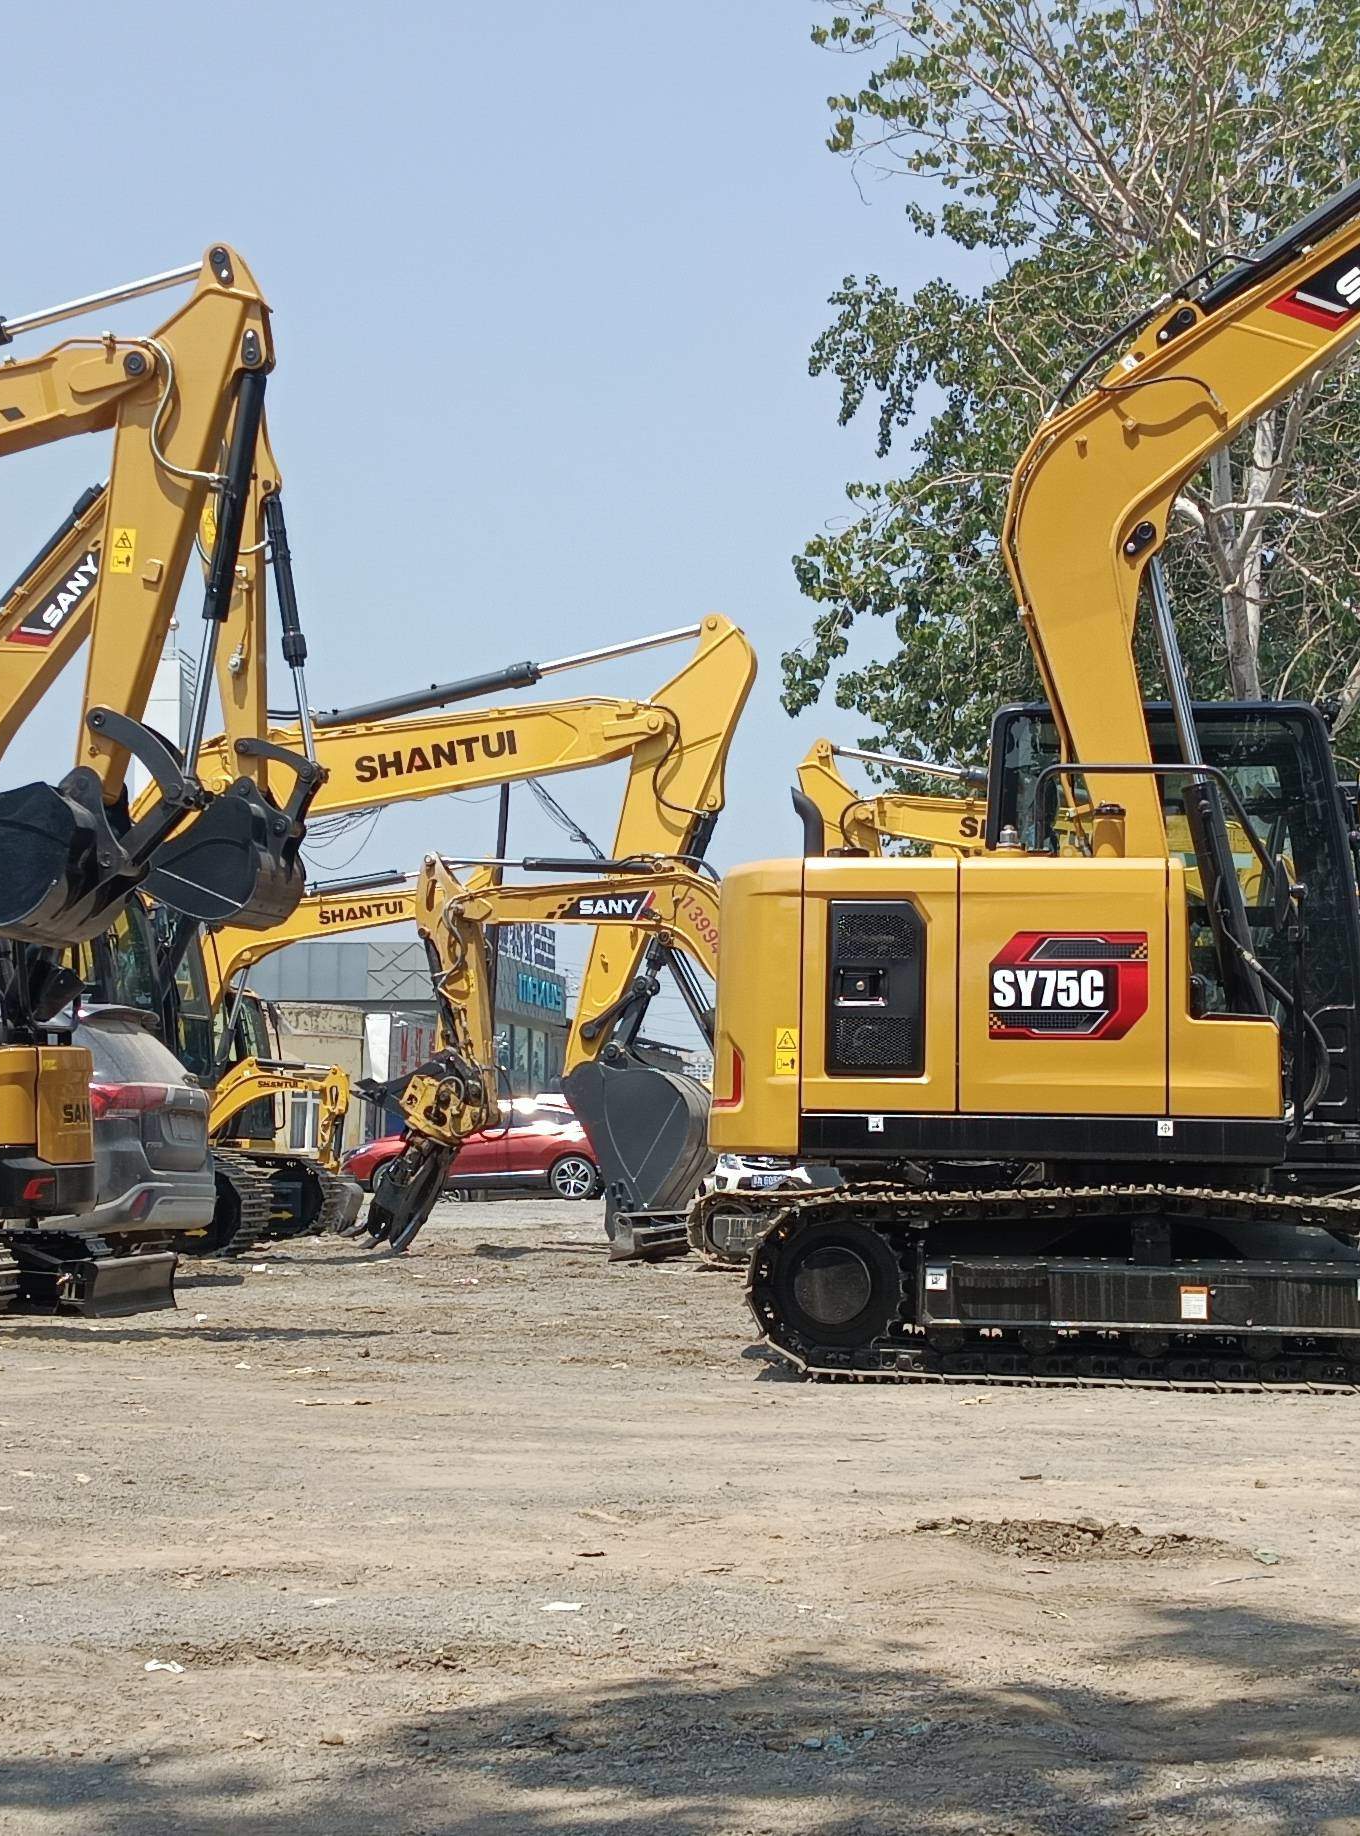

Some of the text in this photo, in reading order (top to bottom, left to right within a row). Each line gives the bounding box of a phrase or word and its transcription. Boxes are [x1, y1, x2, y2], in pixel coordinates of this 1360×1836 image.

[42, 553, 98, 629] SANY
[355, 729, 518, 783] SHANTUI
[319, 901, 404, 925] SHANTUI
[579, 899, 638, 915] SANY
[993, 968, 1104, 1009] SY75C
